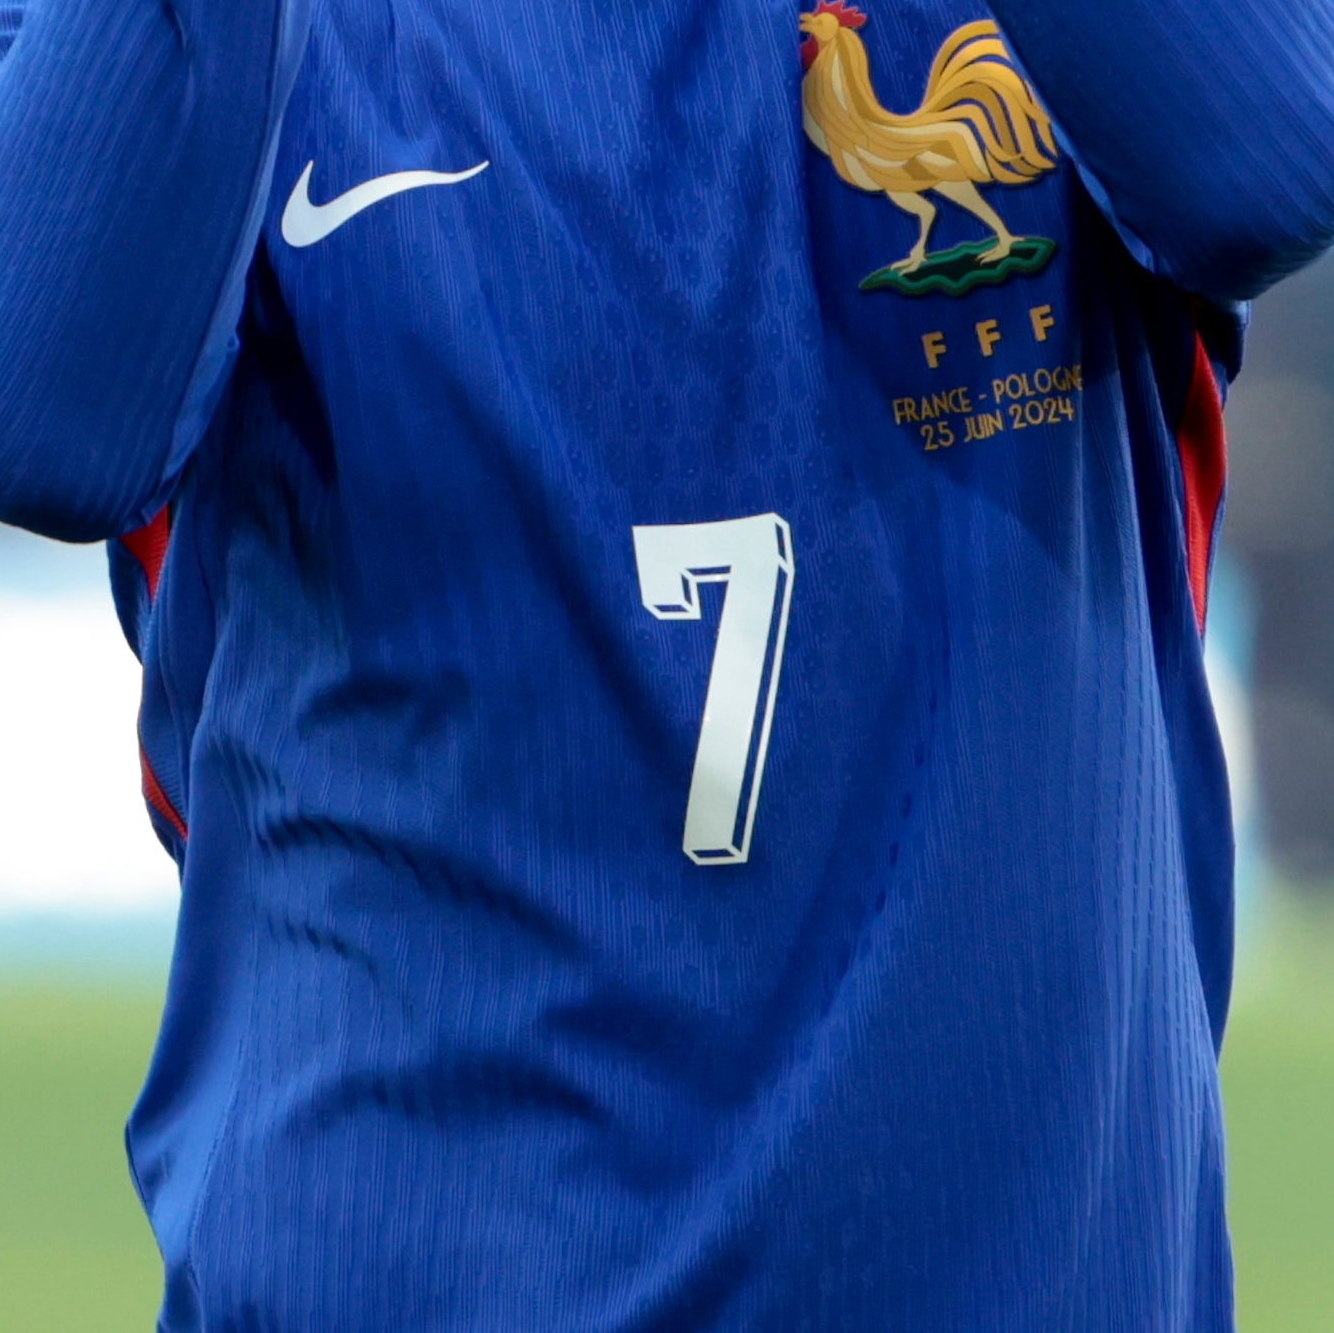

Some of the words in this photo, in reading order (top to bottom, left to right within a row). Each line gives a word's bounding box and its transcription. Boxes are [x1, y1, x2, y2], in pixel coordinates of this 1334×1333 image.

[921, 331, 947, 368] F
[975, 319, 1001, 357] F
[1029, 305, 1055, 342] F
[892, 387, 973, 425] FRANCE
[920, 421, 955, 451] 25
[964, 410, 1005, 443] JUIN
[1009, 396, 1075, 430] 2024
[632, 512, 795, 865] 7
